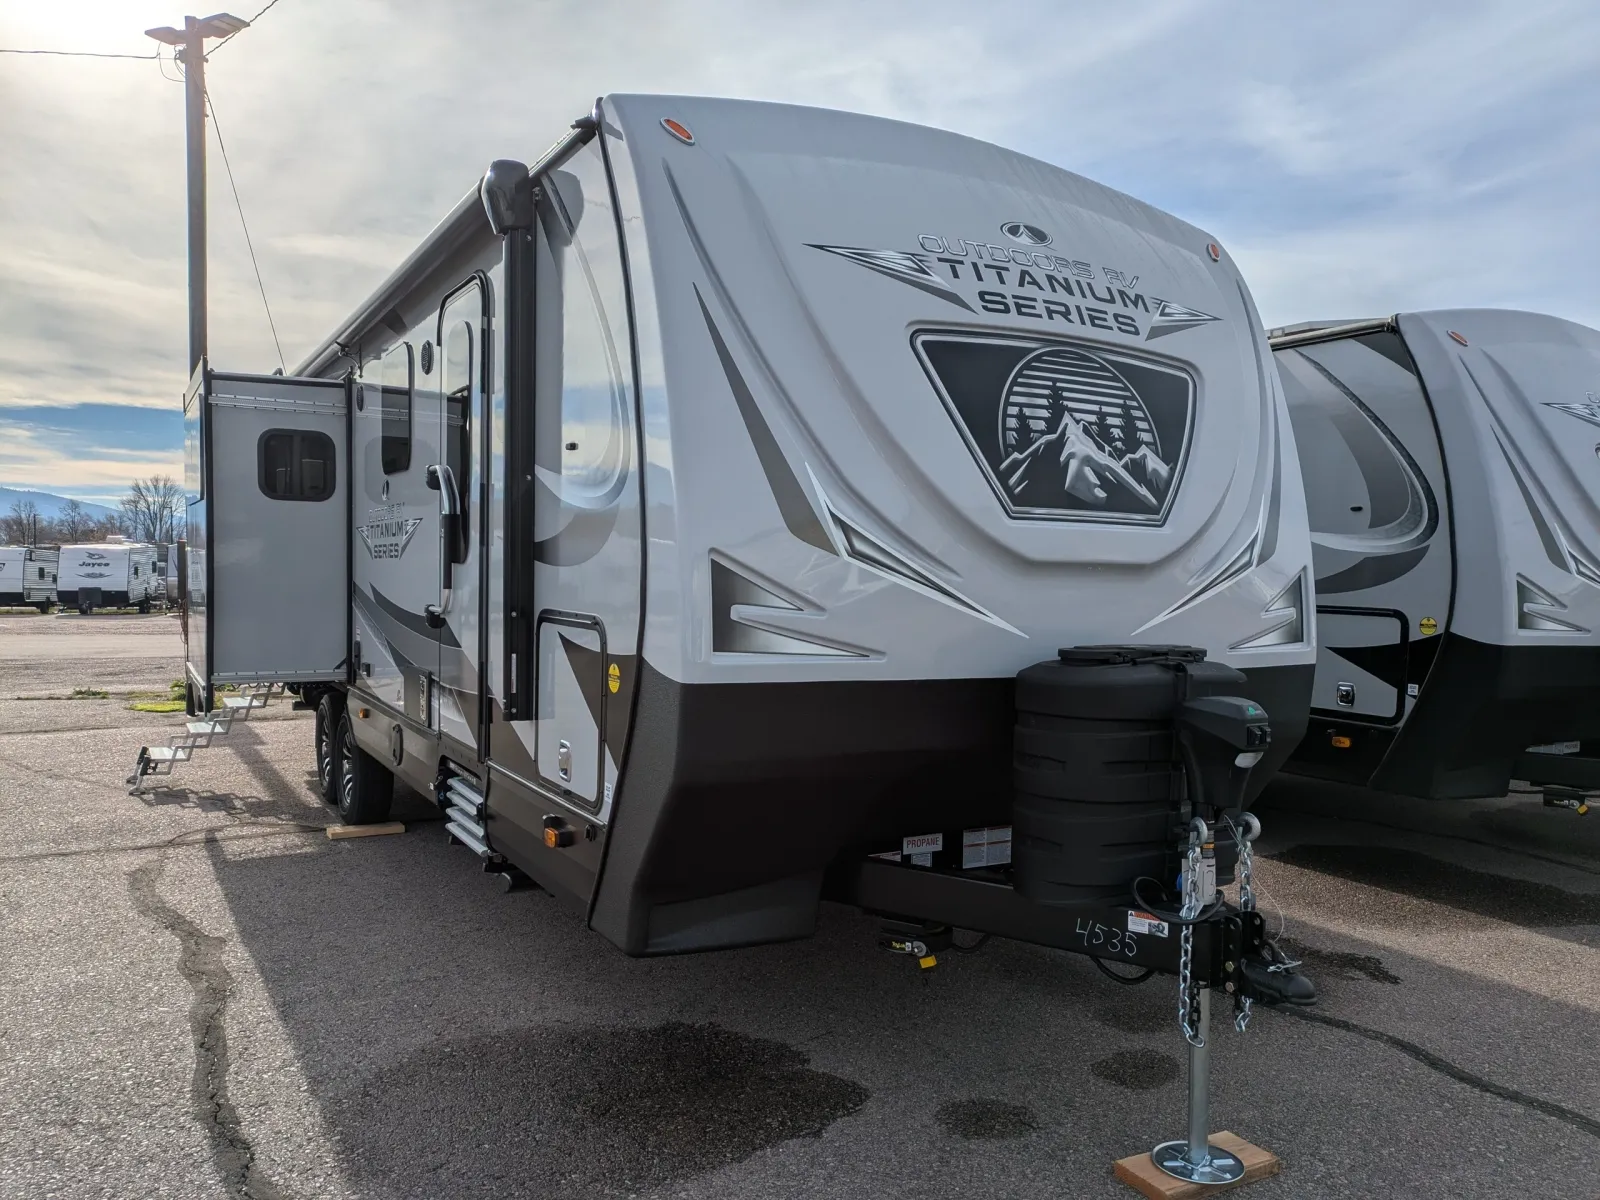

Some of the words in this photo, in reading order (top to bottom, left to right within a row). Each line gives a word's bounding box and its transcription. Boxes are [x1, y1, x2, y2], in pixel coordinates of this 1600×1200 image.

[917, 233, 1096, 280] OUTDOORS
[1101, 266, 1140, 290] RV
[936, 256, 1151, 314] TITANIUM
[977, 290, 1141, 337] SERIES
[369, 520, 404, 540] TITANIUM
[78, 560, 111, 568] Jayco
[373, 542, 400, 559] SERIES
[906, 836, 940, 849] PROPANE
[1075, 917, 1138, 958] 4535
